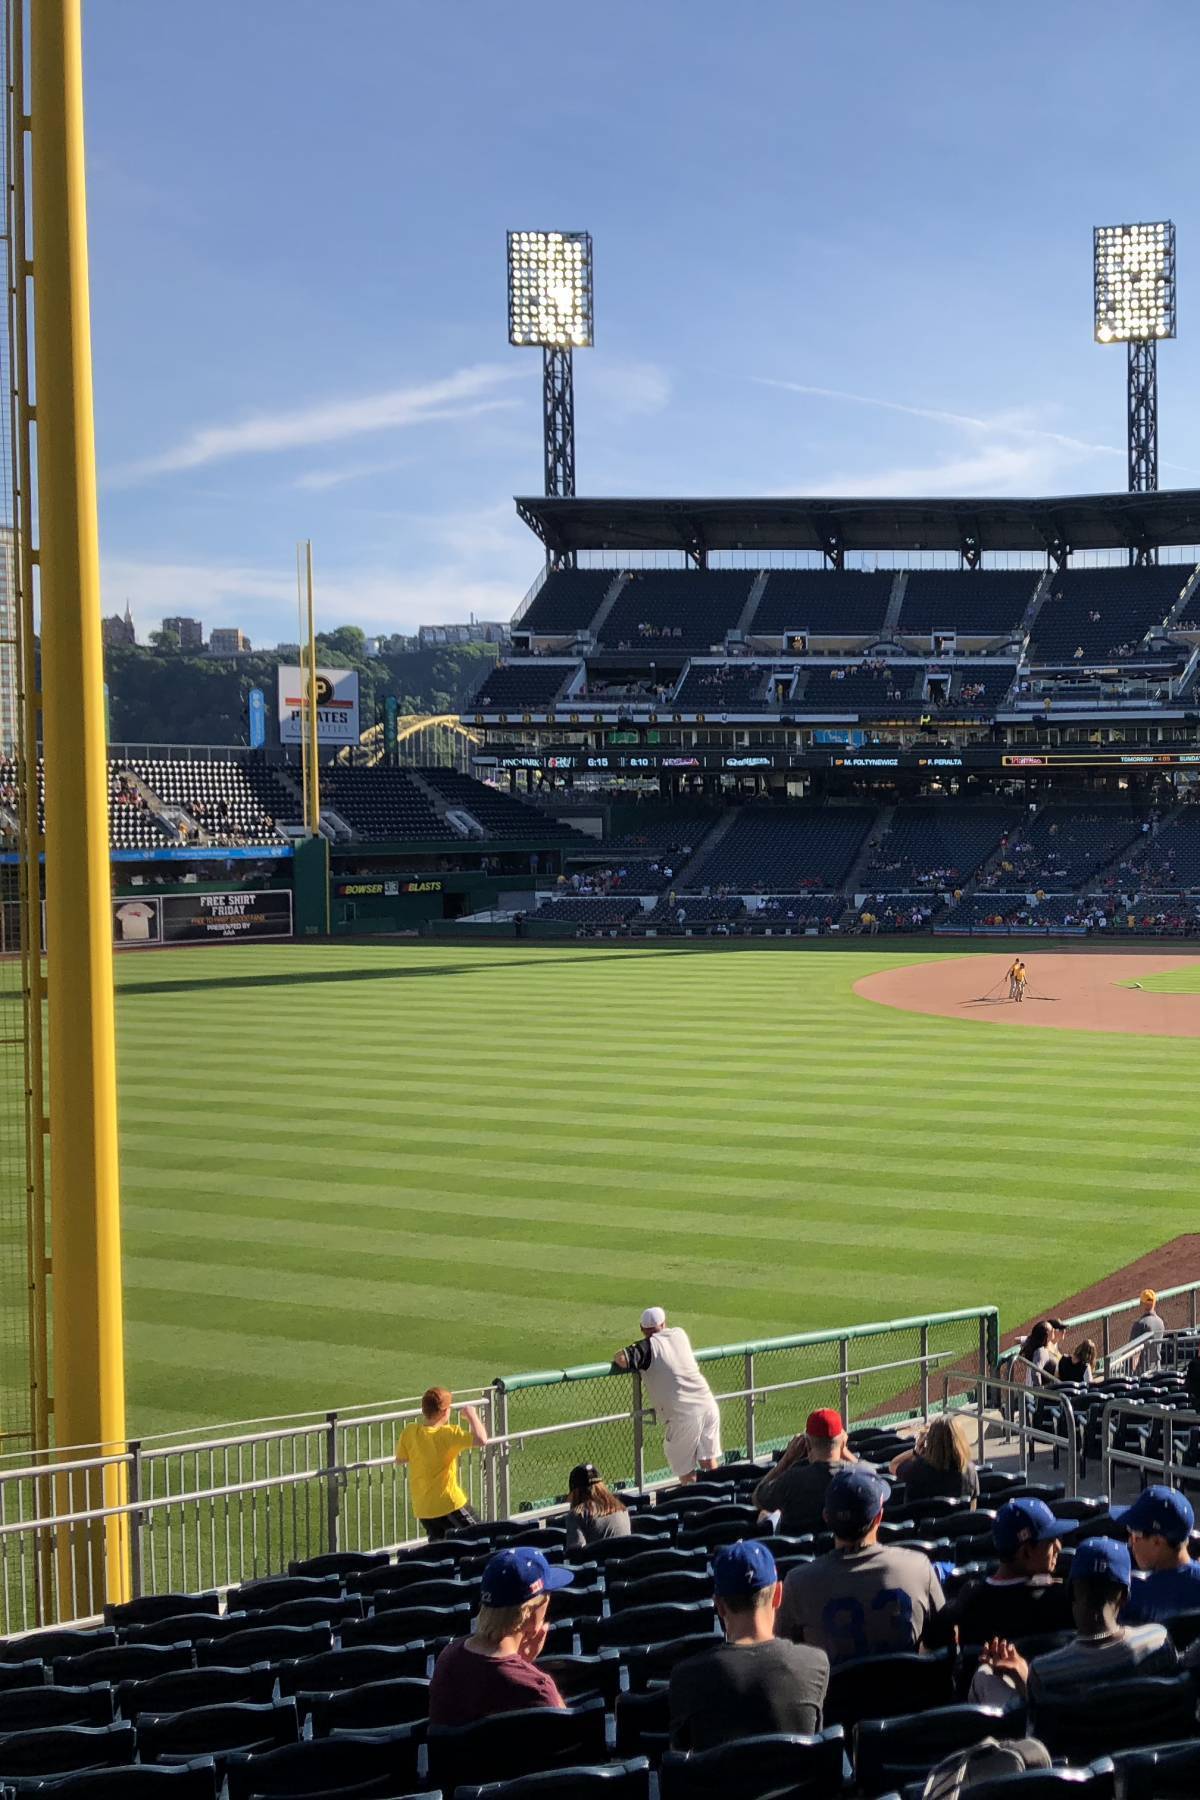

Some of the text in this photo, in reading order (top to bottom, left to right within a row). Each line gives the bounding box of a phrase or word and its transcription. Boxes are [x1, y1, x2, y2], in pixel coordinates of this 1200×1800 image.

[502, 758, 541, 767] PNC PARK
[587, 757, 609, 767] 6:15
[630, 758, 649, 766] 8:10
[934, 758, 962, 766] PERALTA
[1121, 755, 1154, 763] TOMORROW
[345, 885, 383, 894] BOWSER
[408, 882, 441, 892] BLASTS
[200, 894, 256, 907] FREE SHIRT
[212, 905, 246, 916] FRIDAY
